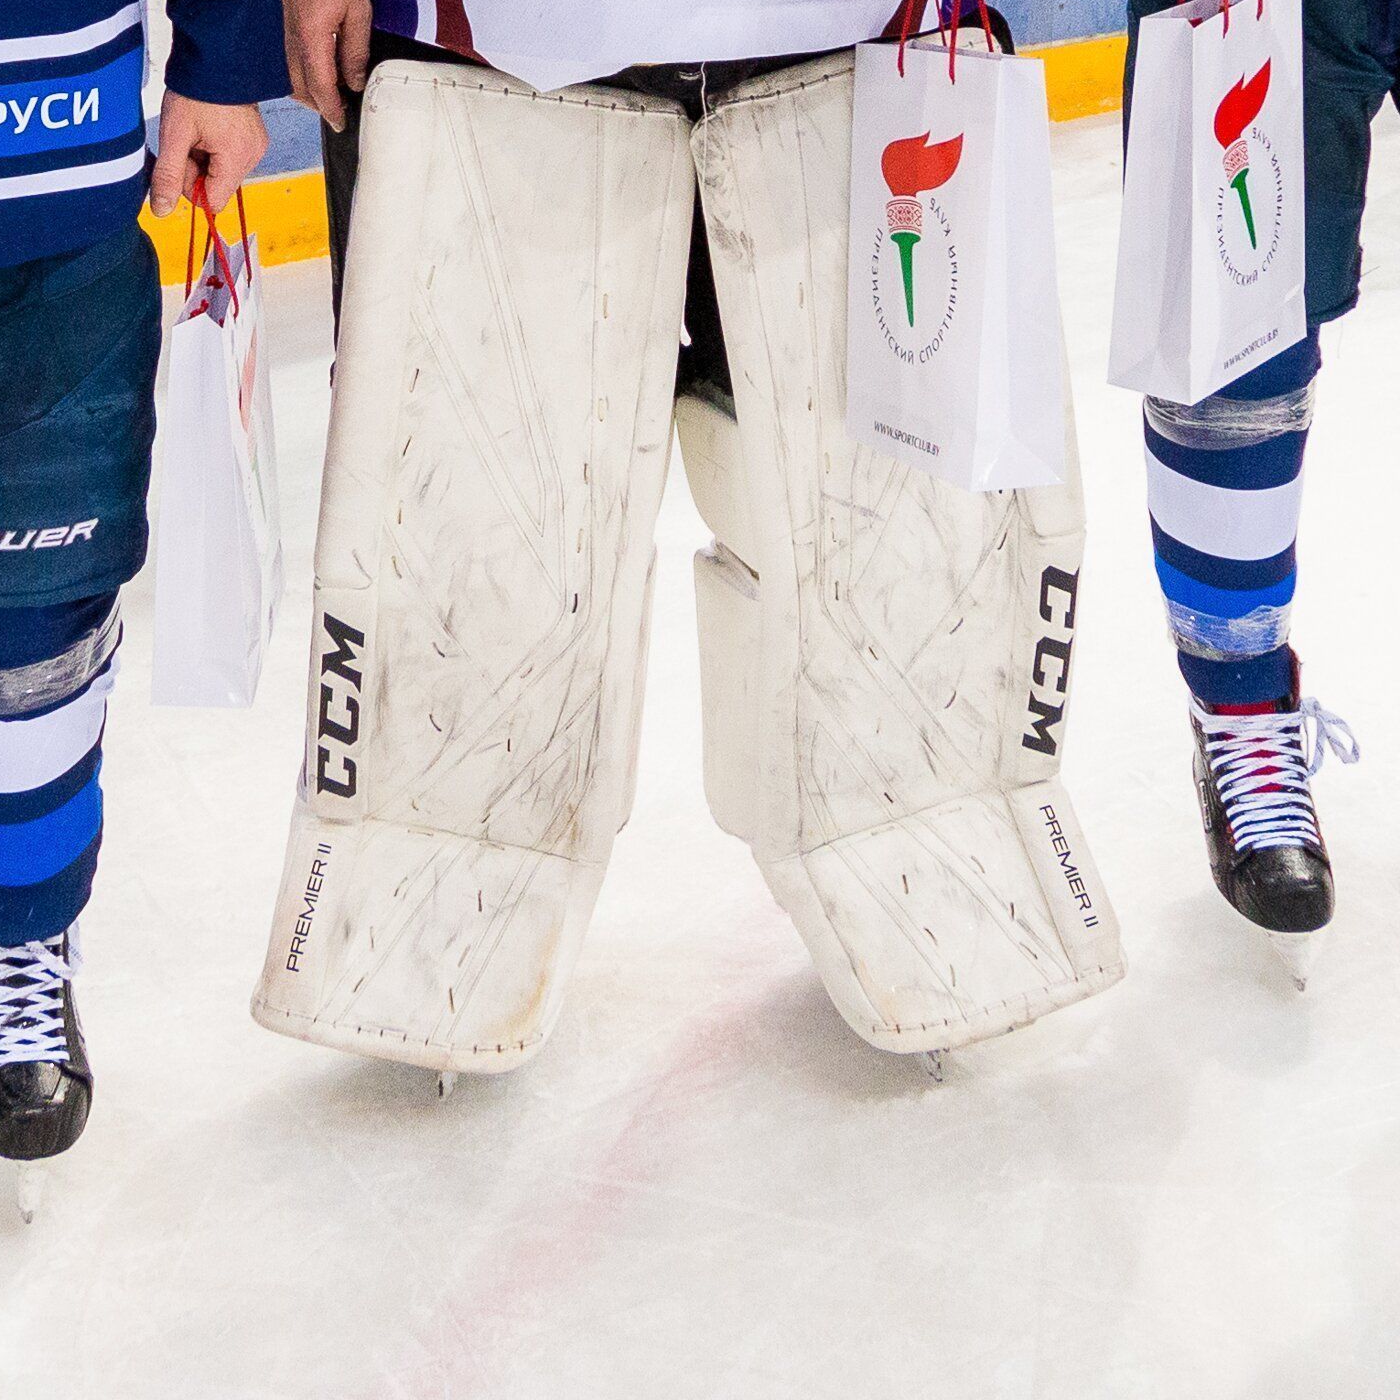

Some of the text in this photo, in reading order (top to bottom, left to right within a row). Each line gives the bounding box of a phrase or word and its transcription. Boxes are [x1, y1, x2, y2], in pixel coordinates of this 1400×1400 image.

[871, 197, 959, 365] ПРЕЗИДЕНТСКИЙ СПОРТИВНЫЙ КЛУБ
[1215, 186, 1259, 287] ПРЕЗИДЕНТСКИЙ
[316, 611, 366, 799] CCM
[1021, 565, 1081, 757] CCM
[285, 858, 329, 973] PREMIER
[1038, 804, 1093, 911] PREMIER
